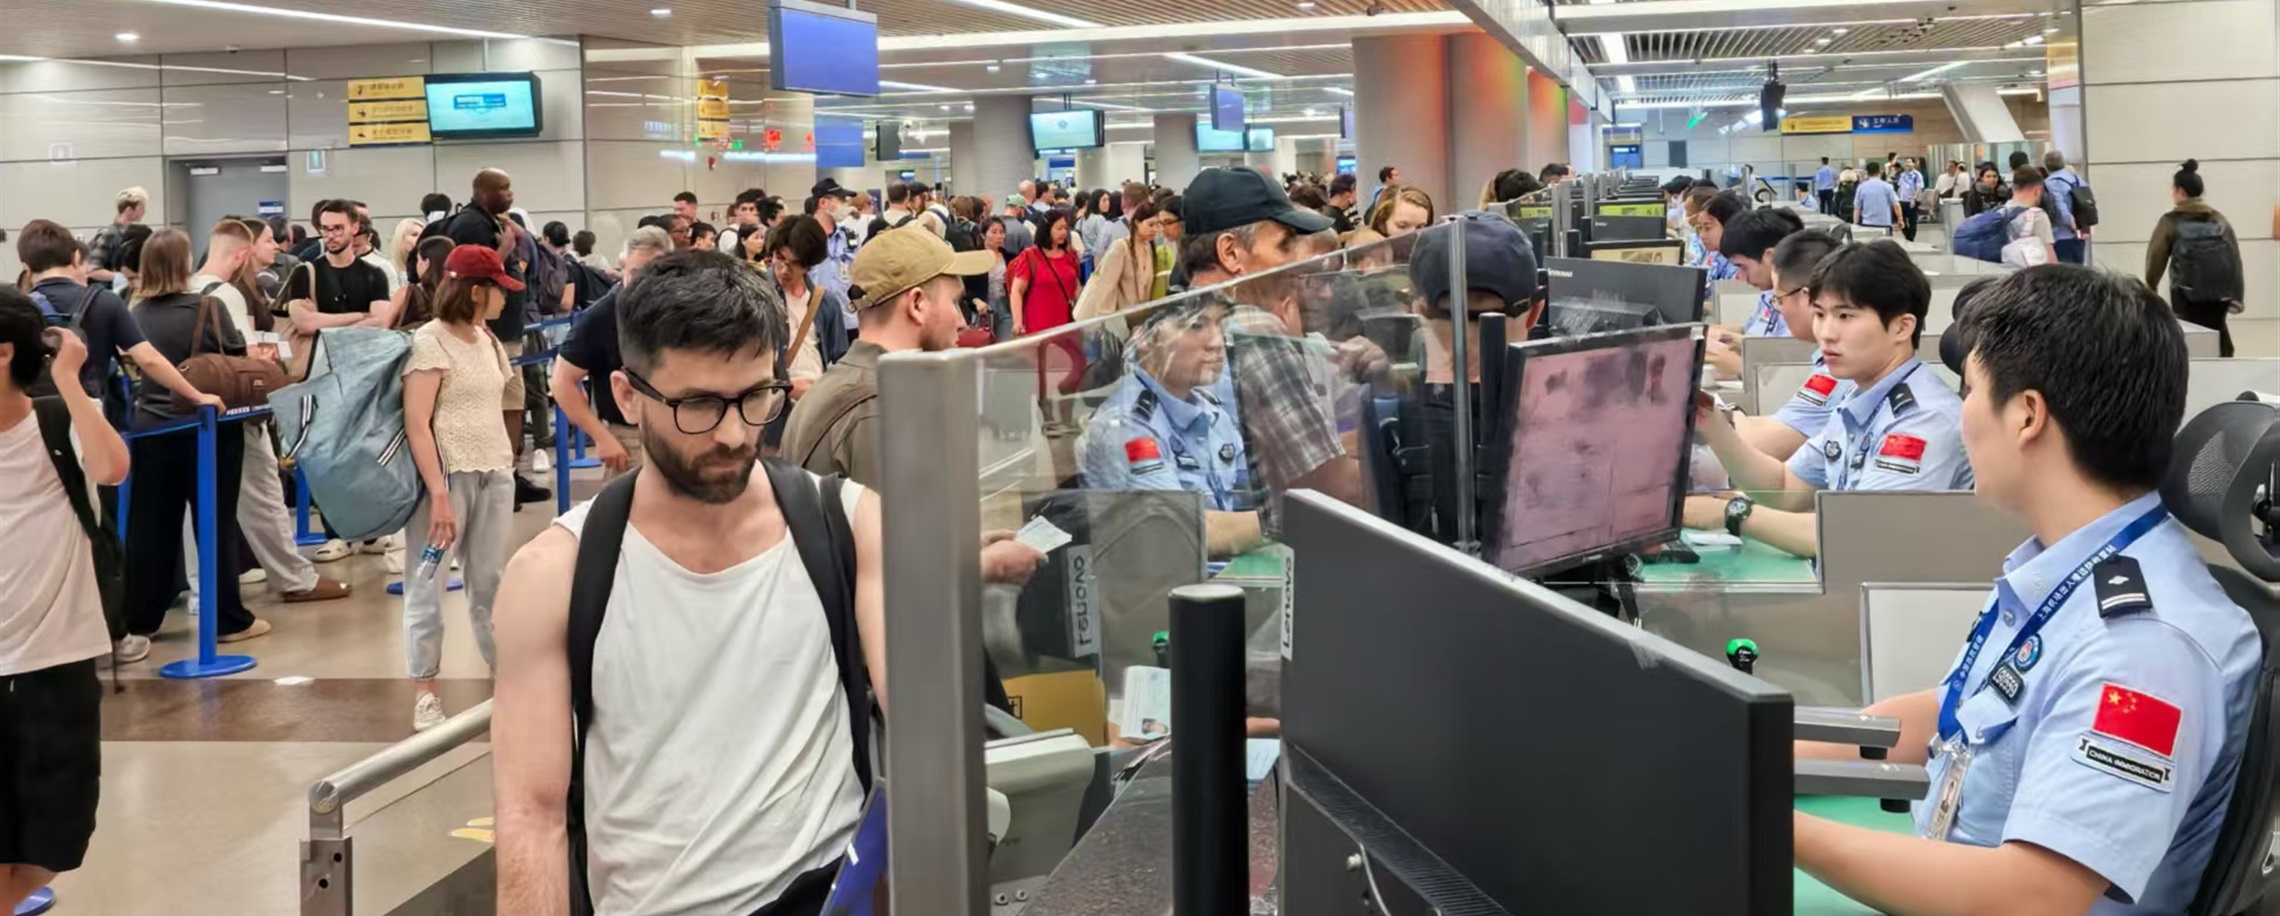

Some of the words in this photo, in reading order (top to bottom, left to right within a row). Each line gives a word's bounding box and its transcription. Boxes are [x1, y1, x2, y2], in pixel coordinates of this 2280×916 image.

[1283, 556, 1292, 649] Lenovo
[2088, 750, 2114, 764] CHINA
[2114, 759, 2161, 781] IMMIGRATION
